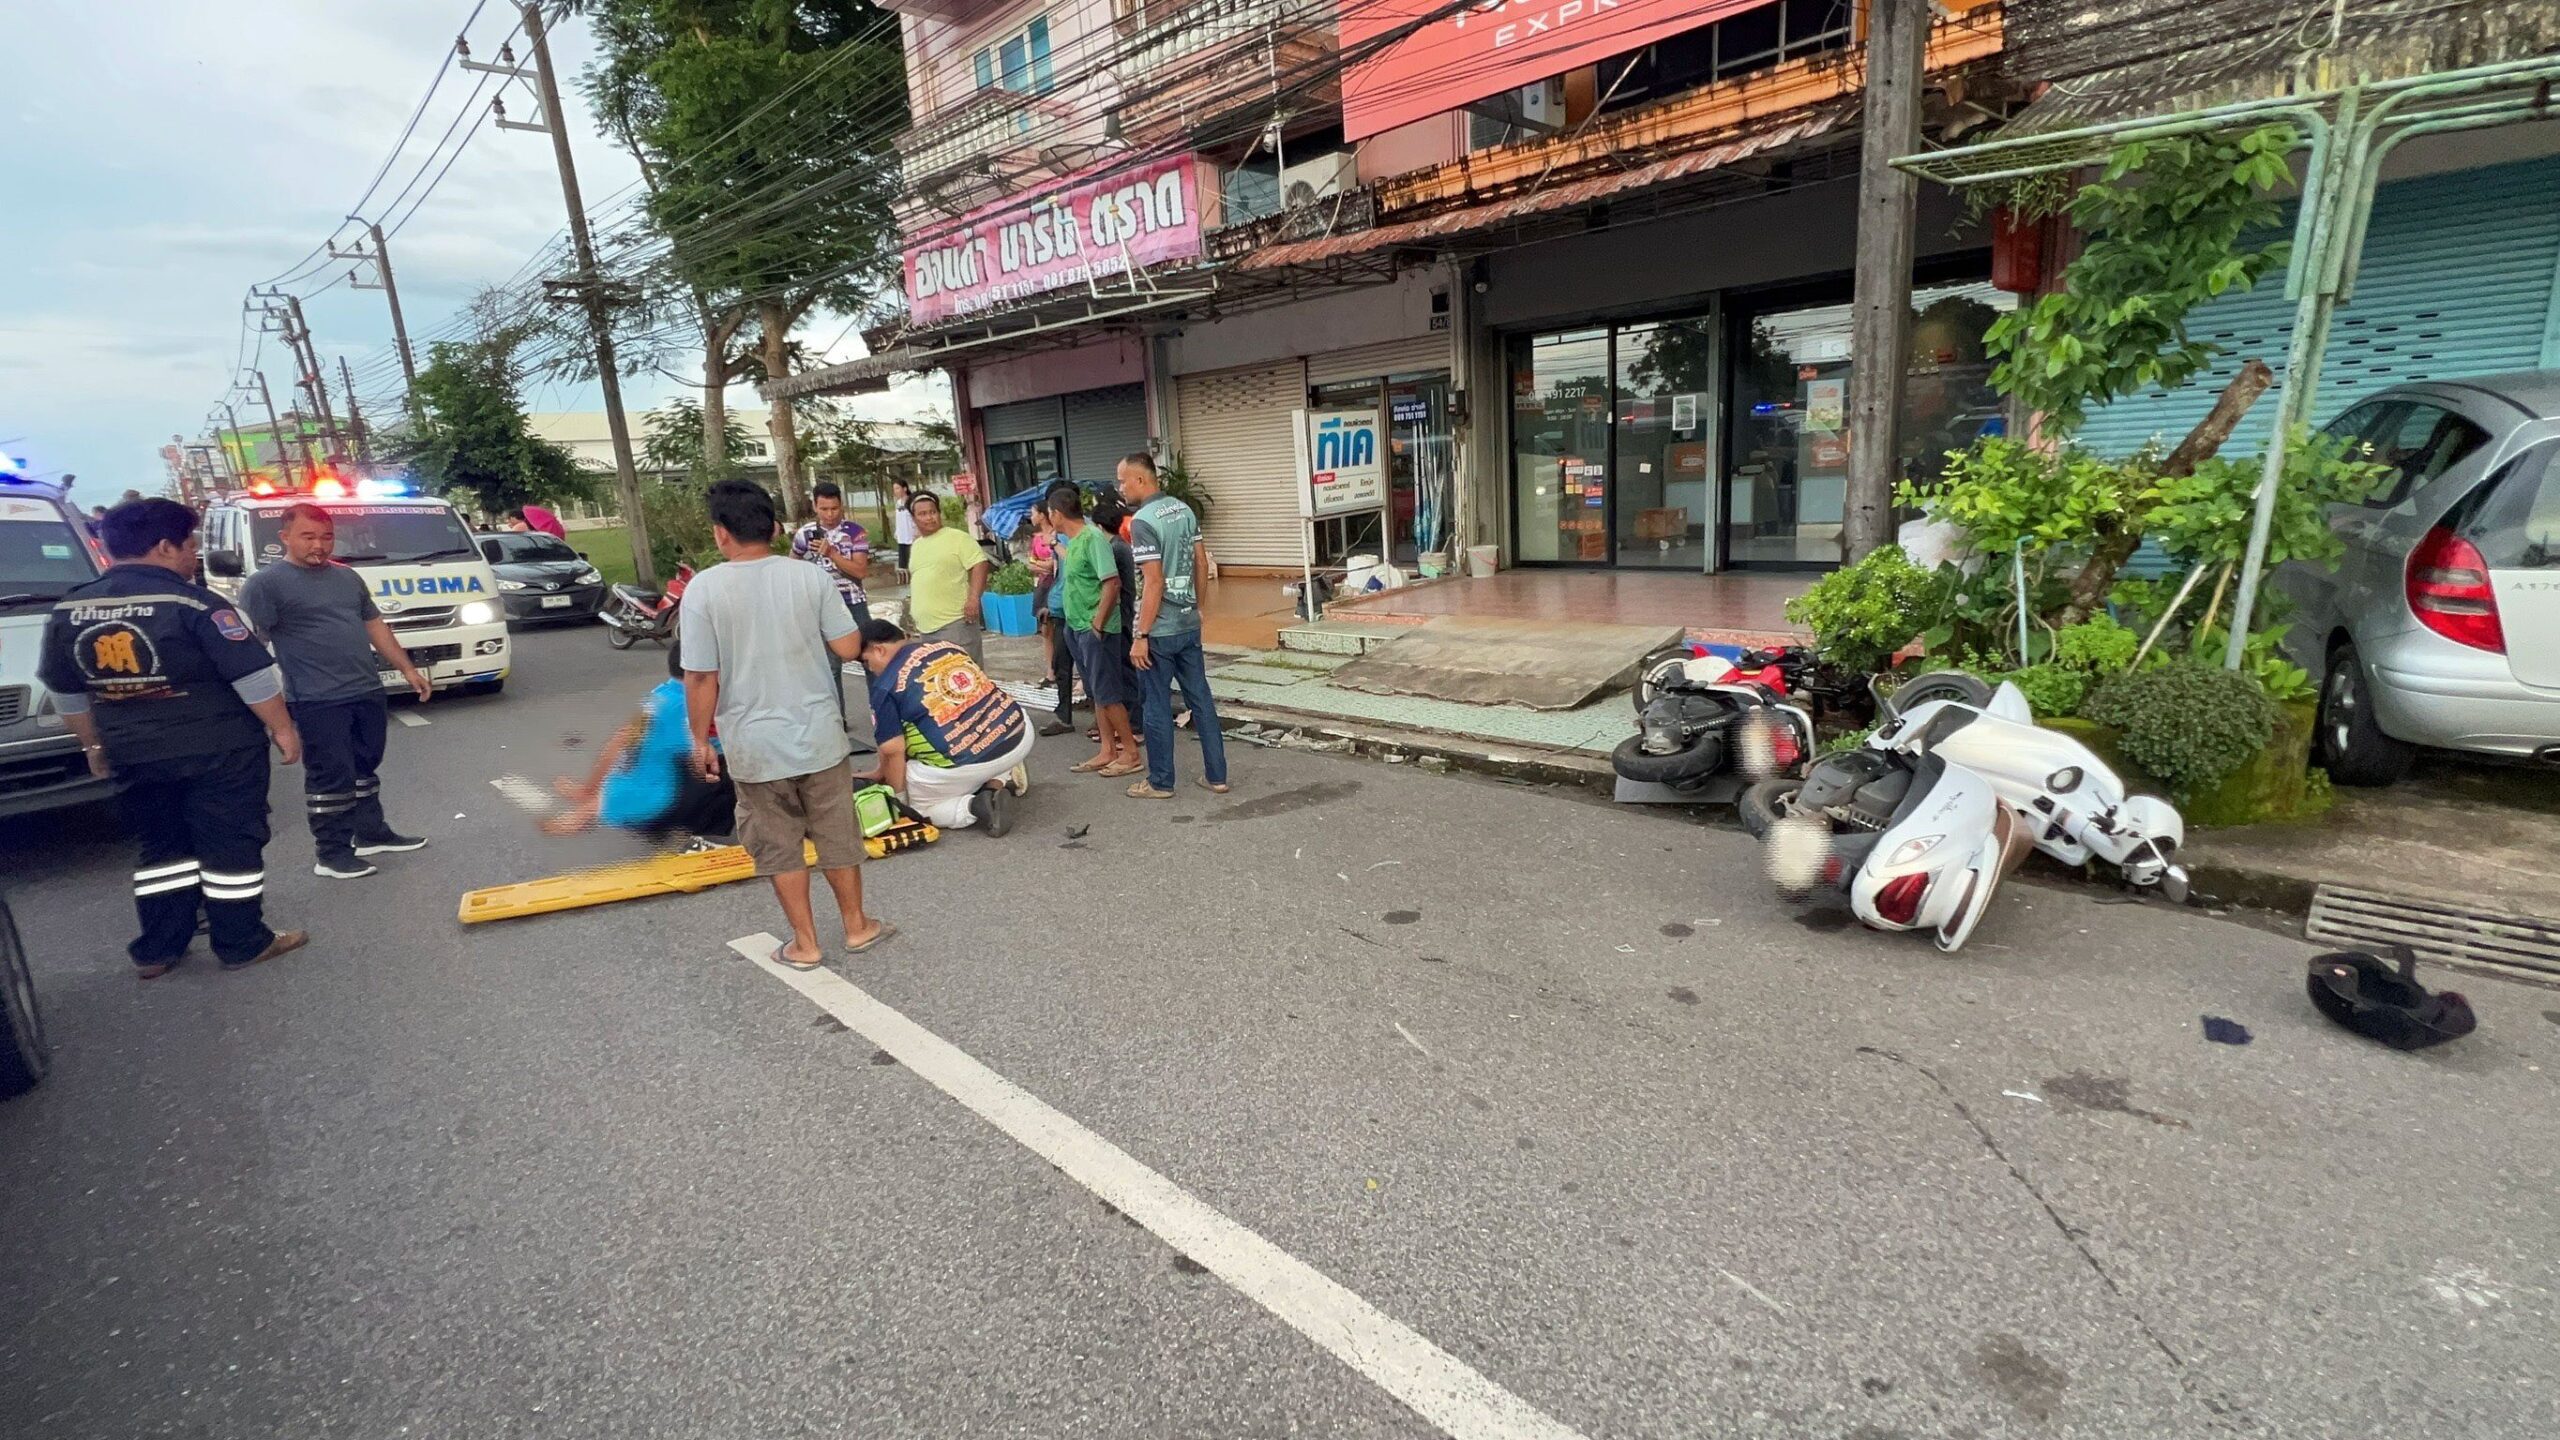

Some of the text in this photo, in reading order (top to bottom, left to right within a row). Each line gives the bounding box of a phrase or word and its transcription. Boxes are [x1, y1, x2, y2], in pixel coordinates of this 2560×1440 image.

[1091, 170, 1185, 247] ตราด
[1565, 386, 1587, 399] 2217
[1316, 417, 1374, 471] ทีเค
